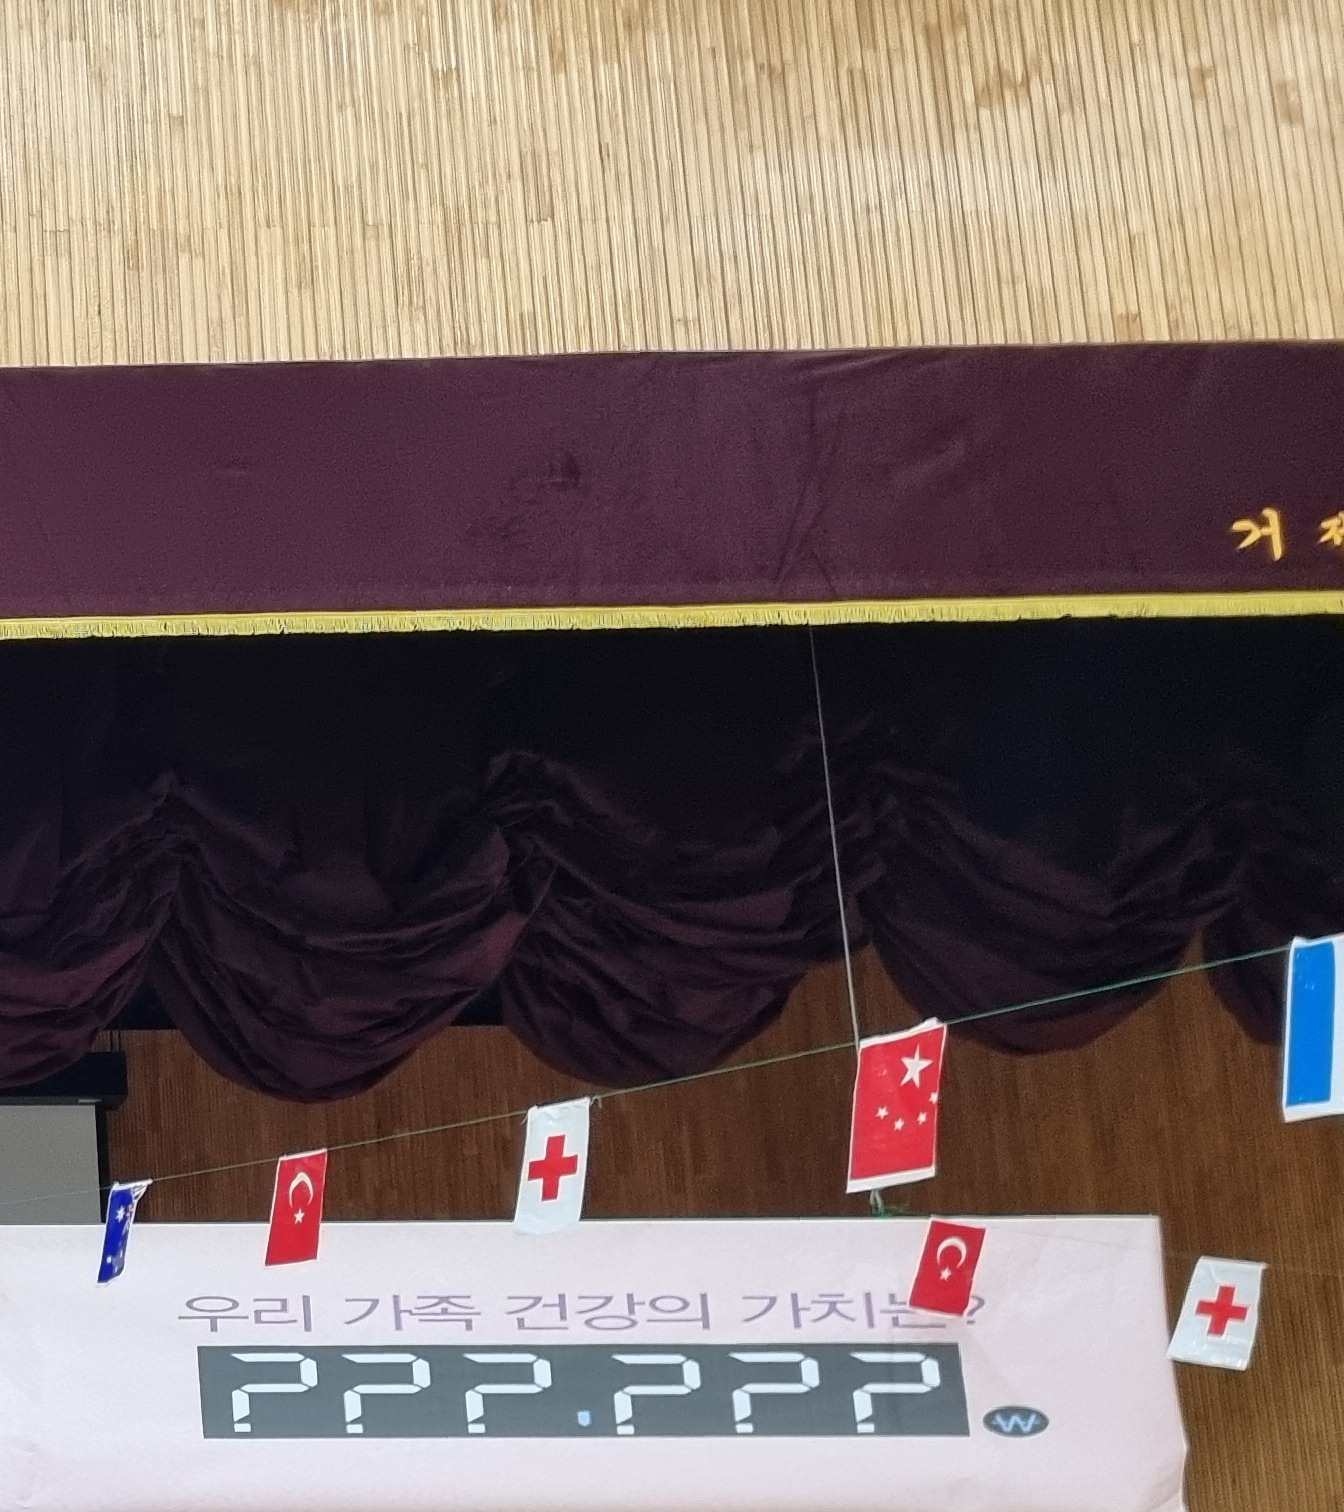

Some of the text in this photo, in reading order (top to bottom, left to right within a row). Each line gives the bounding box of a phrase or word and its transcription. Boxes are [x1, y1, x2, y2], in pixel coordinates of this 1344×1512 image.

[178, 1294, 312, 1333] 우리
[343, 1294, 482, 1332] 가족
[505, 1292, 711, 1331] 건강의
